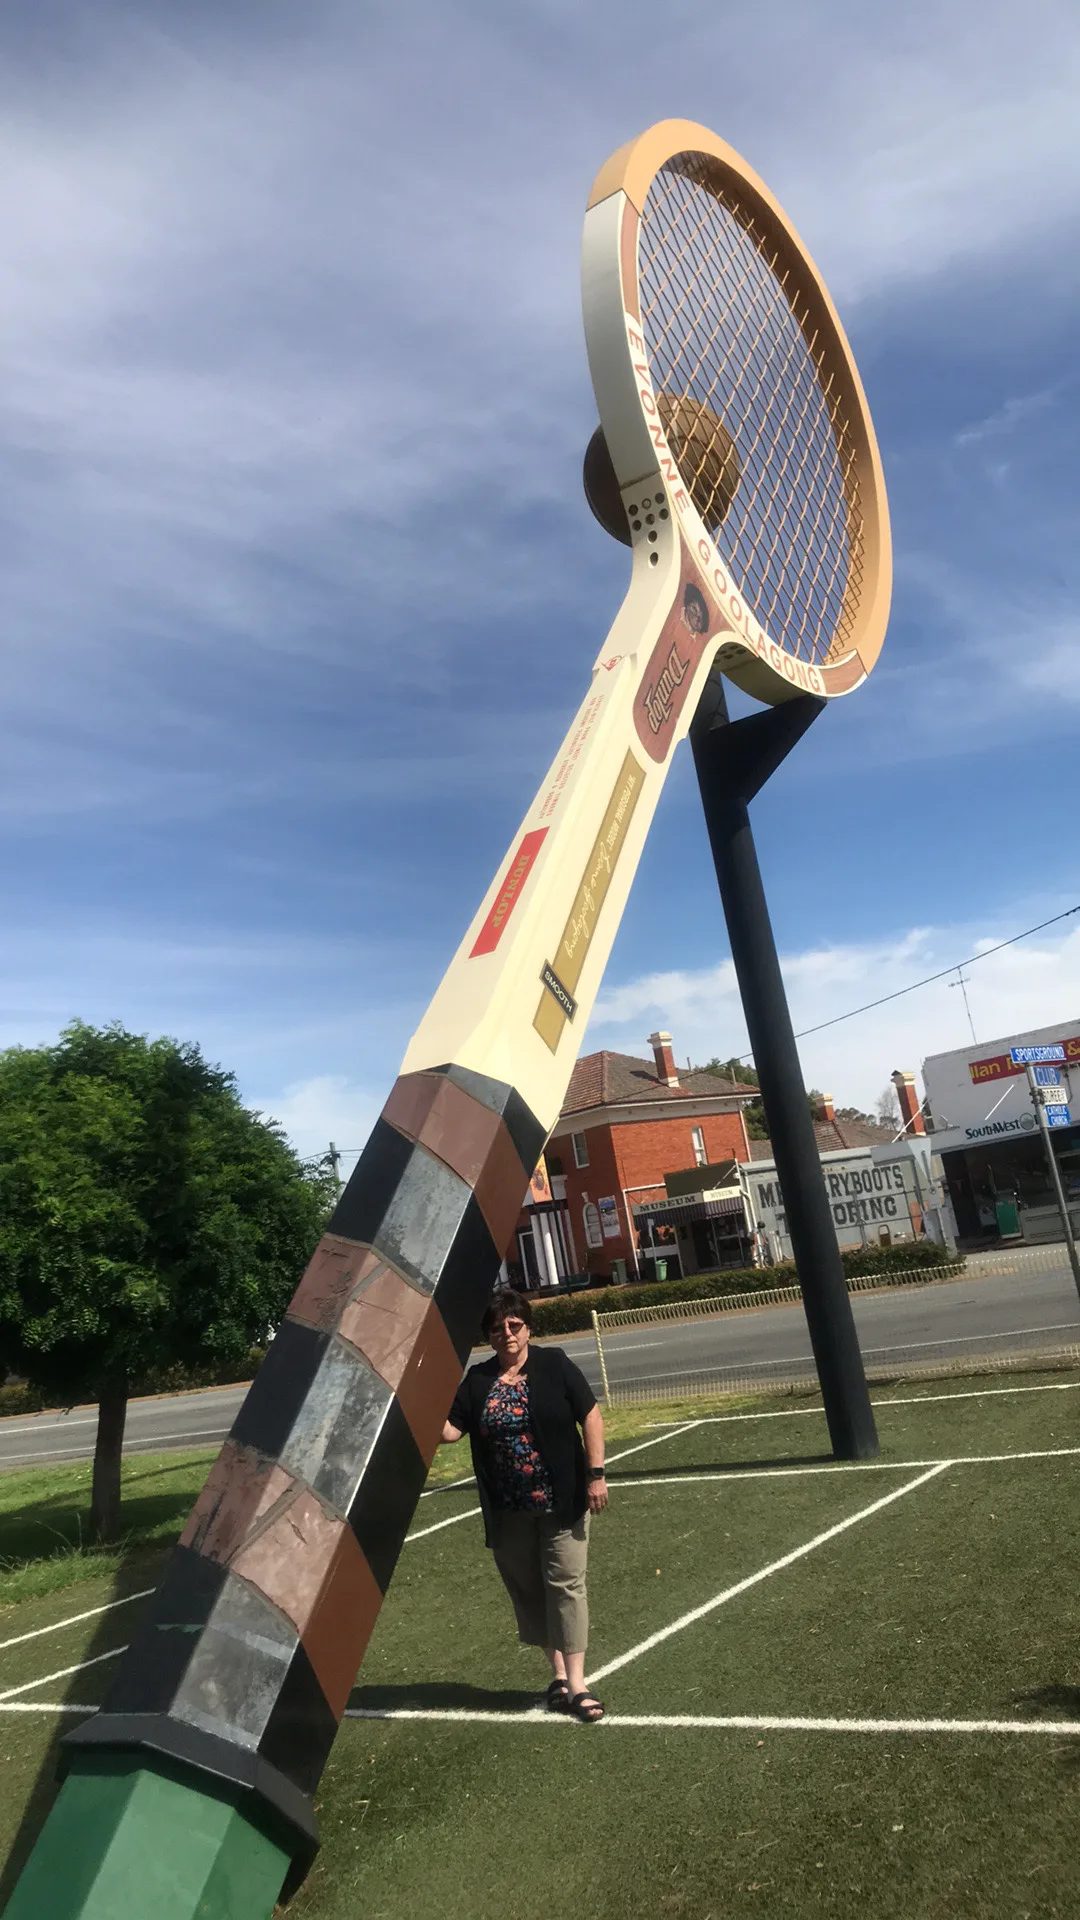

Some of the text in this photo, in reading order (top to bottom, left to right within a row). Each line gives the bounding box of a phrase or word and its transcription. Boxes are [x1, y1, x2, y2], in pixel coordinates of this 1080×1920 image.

[628, 326, 821, 694] EVONNE GOOLAGONG
[643, 642, 690, 735] Dunlop
[615, 785, 632, 823] PERSONAL
[491, 855, 531, 929] DUNLOP
[544, 970, 573, 1013] SMOOTH
[1015, 1046, 1065, 1061] SPORTSGROUND
[1036, 1067, 1058, 1086] CLUB
[1047, 1105, 1068, 1116] CATHOLIC
[1050, 1115, 1068, 1126] CHURCH
[639, 1195, 696, 1213] MUSEUM
